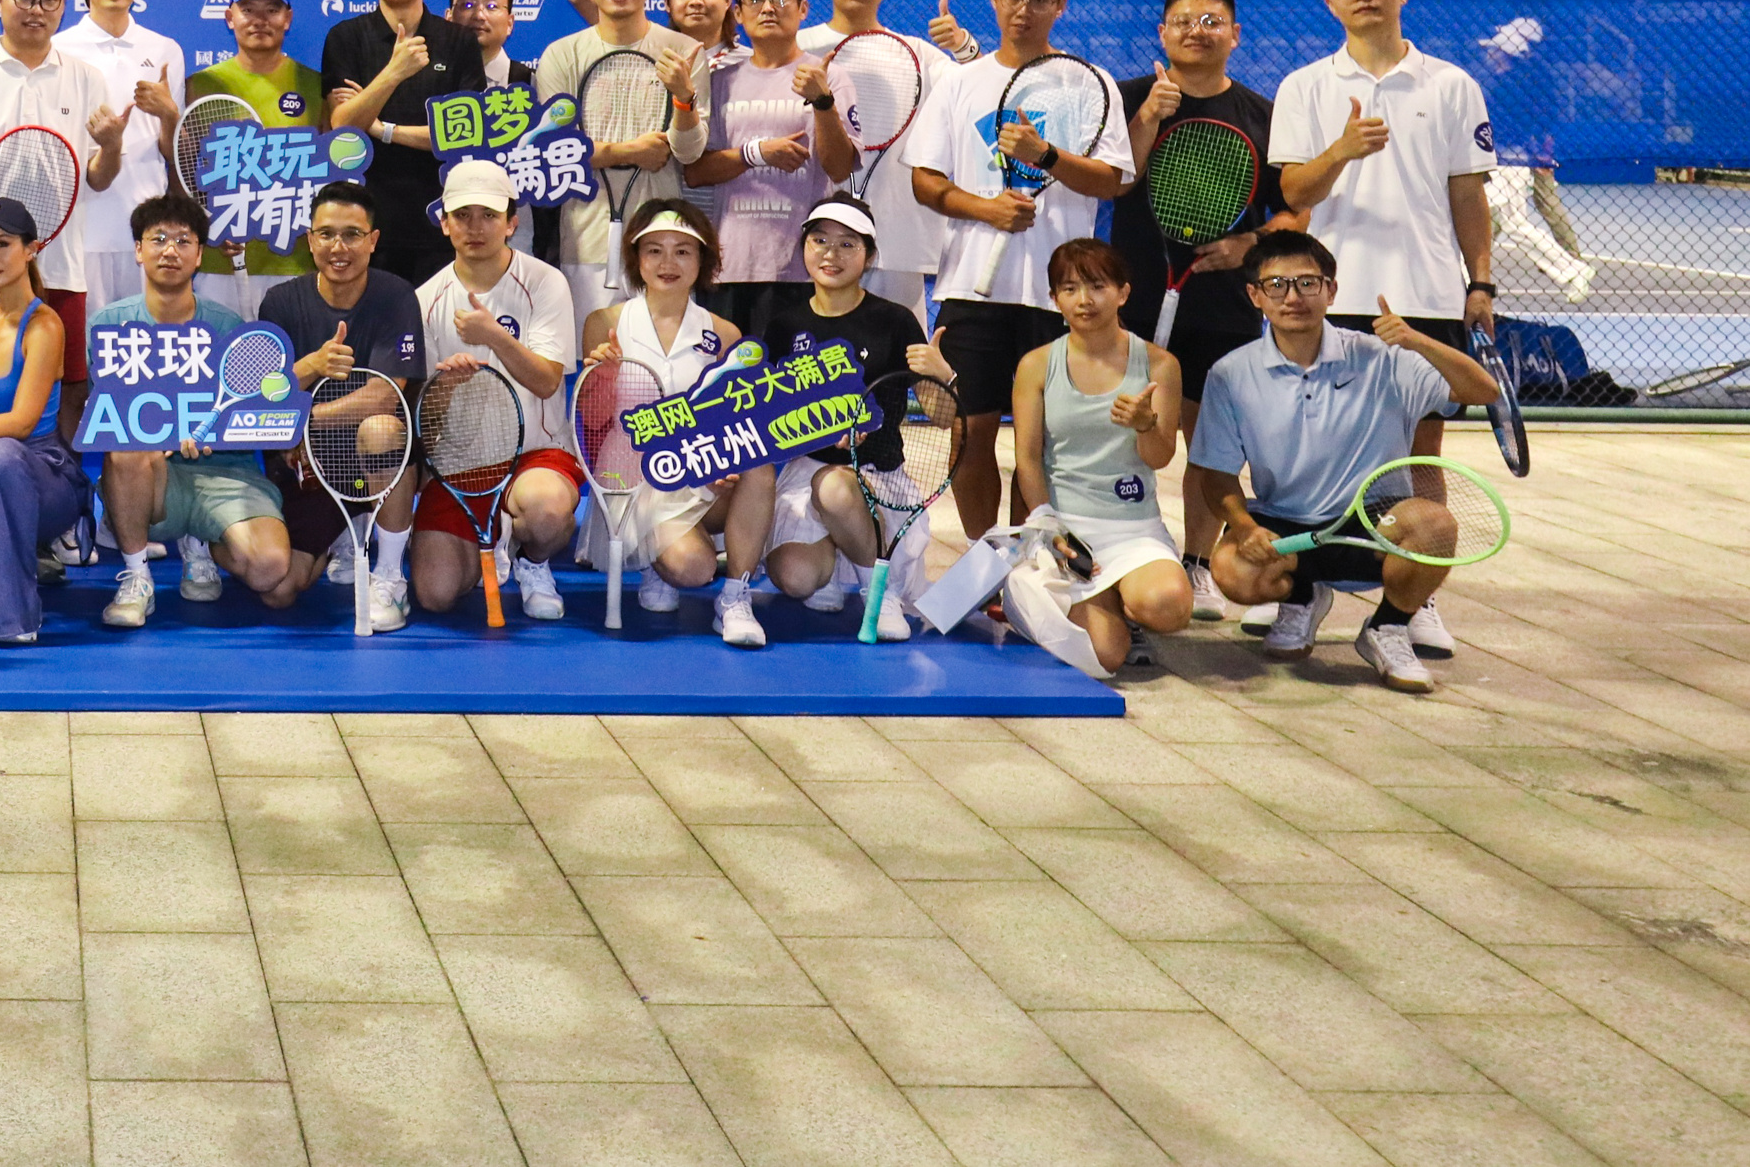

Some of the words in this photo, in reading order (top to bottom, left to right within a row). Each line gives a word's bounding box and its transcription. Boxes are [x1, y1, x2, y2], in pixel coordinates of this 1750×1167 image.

[349, 1, 378, 13] lucki
[282, 99, 301, 109] 209
[432, 87, 534, 151] 圆梦
[201, 125, 329, 190] 敢玩
[97, 327, 215, 385] 球球
[82, 392, 217, 445] ACE
[231, 413, 256, 427] AO
[258, 413, 266, 426] 1
[623, 343, 857, 445] 澳网一分大满贯
[649, 417, 768, 484] @杭州
[1120, 484, 1139, 495] 203
